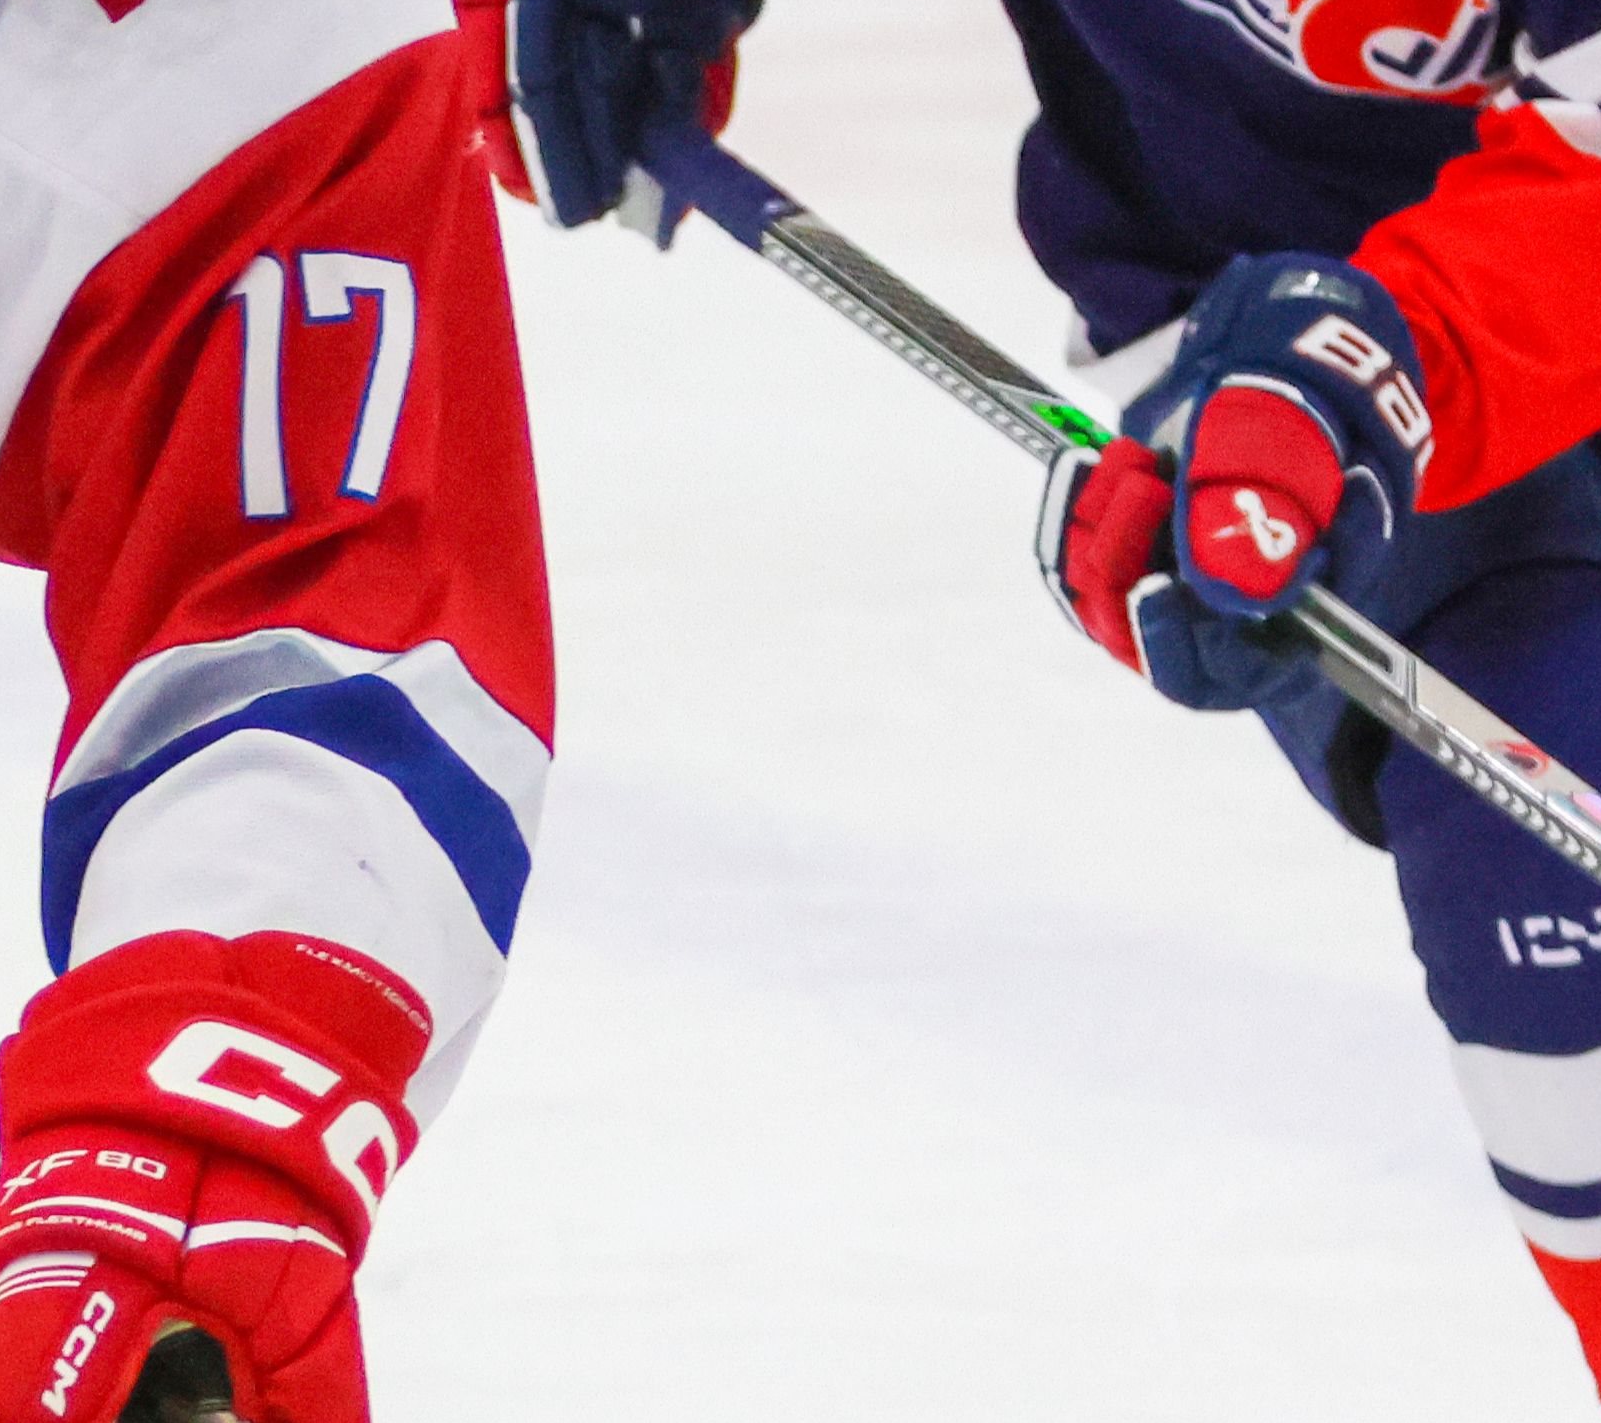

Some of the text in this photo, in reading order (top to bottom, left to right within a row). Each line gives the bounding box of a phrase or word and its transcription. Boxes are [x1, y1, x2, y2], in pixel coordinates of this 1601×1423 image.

[225, 248, 420, 521] 17
[96, 1149, 168, 1181] 80
[41, 1290, 116, 1418] CCM
